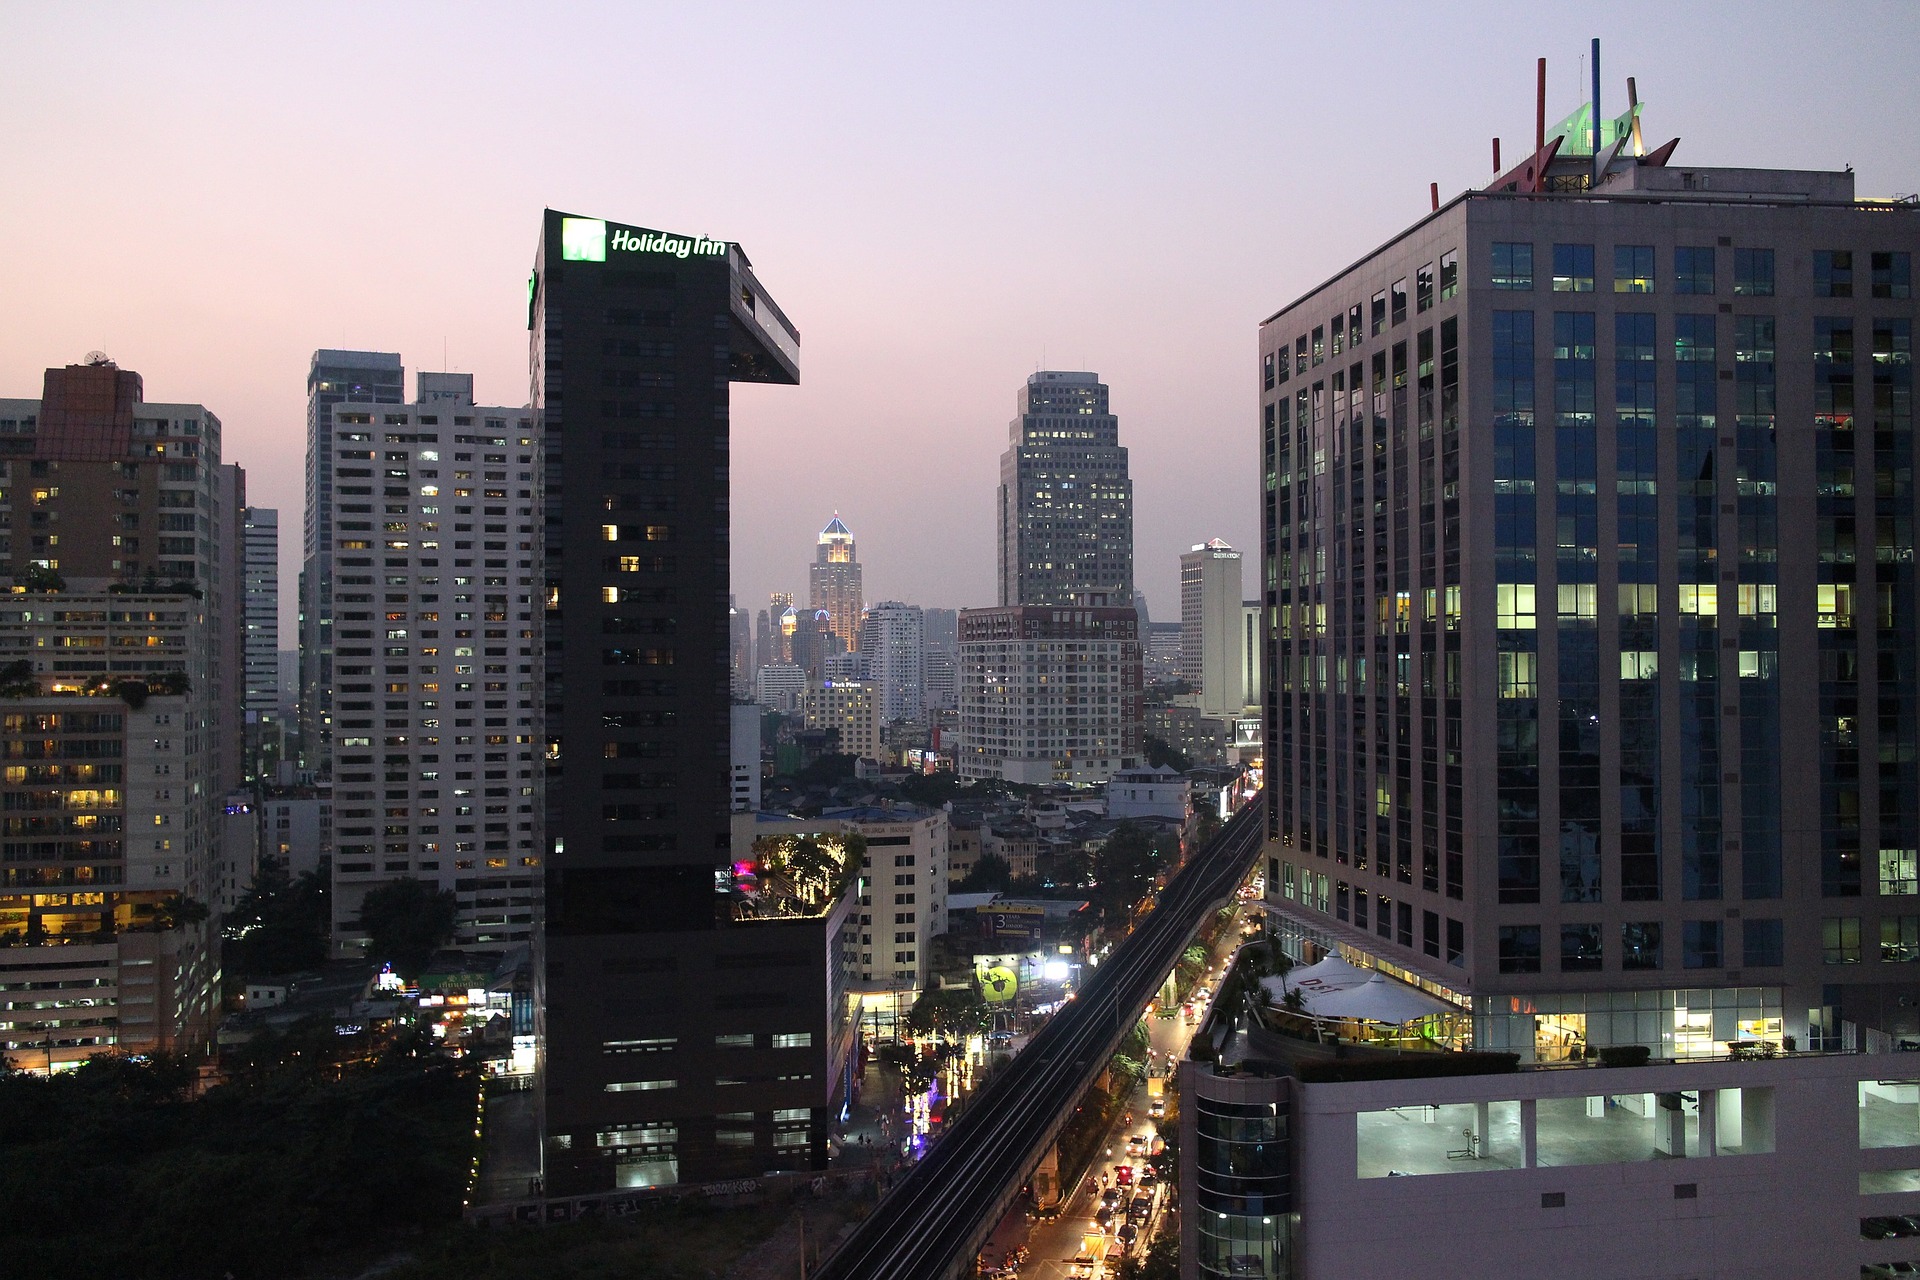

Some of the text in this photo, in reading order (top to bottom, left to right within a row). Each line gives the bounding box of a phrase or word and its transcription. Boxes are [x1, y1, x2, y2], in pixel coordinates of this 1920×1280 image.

[611, 229, 726, 259] Holiday Inn
[996, 914, 1006, 929] 3
